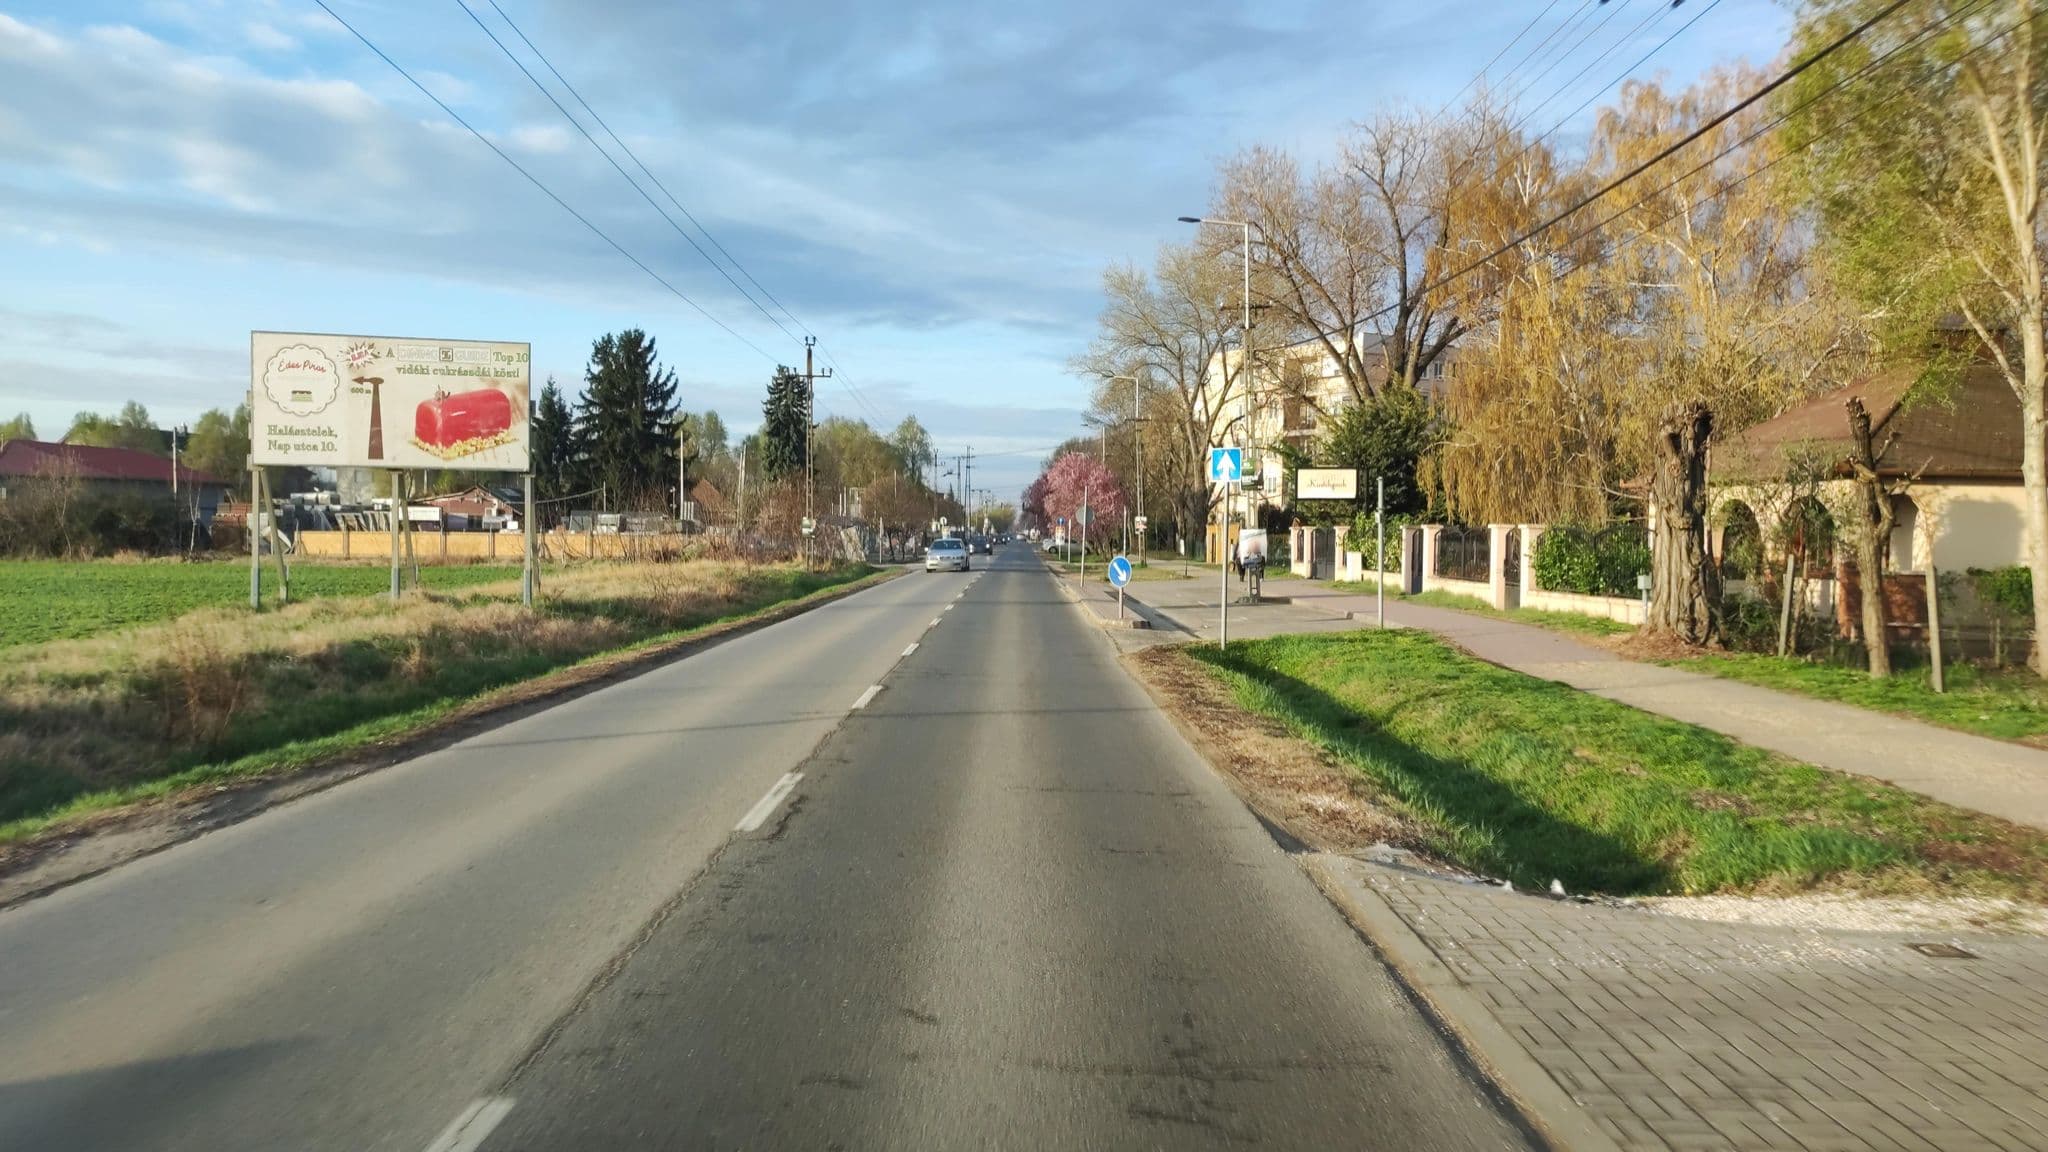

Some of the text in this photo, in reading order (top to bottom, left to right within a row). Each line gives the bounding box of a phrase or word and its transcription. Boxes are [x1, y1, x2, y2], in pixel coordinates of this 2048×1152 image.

[386, 347, 395, 358] A
[493, 351, 514, 365] Top
[516, 352, 529, 363] 10
[396, 364, 431, 376] vidéki
[268, 440, 338, 454] Nap utca 10.
